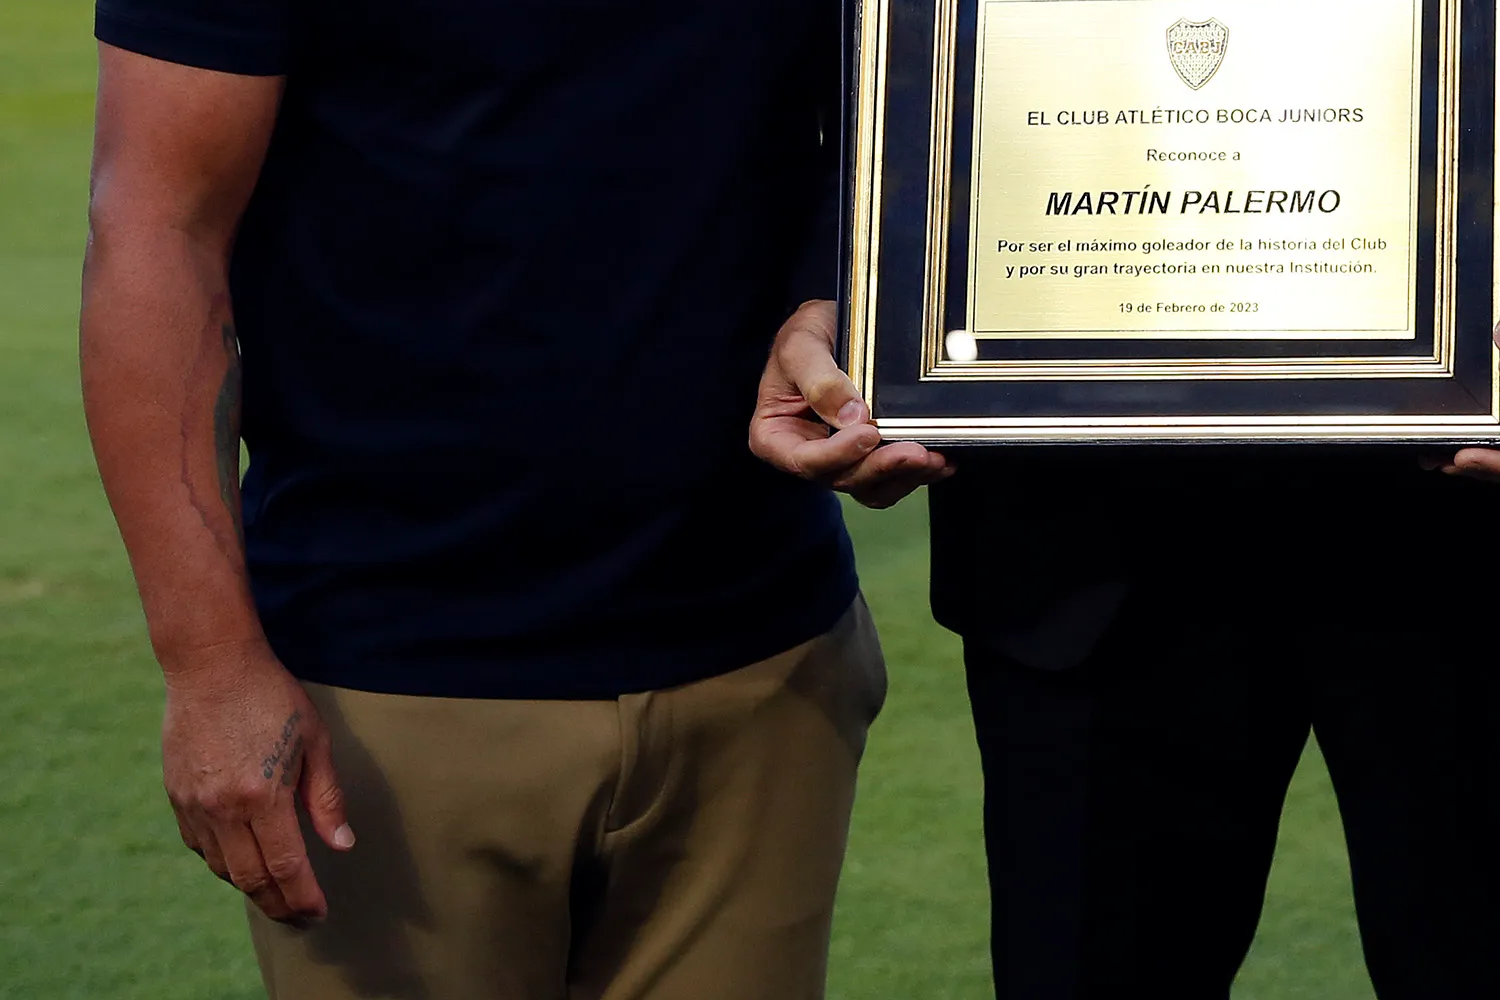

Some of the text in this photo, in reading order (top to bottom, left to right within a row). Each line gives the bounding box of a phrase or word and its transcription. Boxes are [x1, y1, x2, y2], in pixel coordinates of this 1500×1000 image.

[1027, 105, 1365, 126] EL CLUB ATLÉTICO BOCA JUNIORS
[1146, 148, 1242, 162] Reconoce a
[1045, 184, 1342, 216] MARTÍN PALERMO
[997, 236, 1388, 255] Por ser el máximo goleador de la historia del Club
[1005, 260, 1378, 279] y por su gran trayectoria en nuestra Institución.
[1118, 302, 1260, 314] 19 de Febrero de 2023
